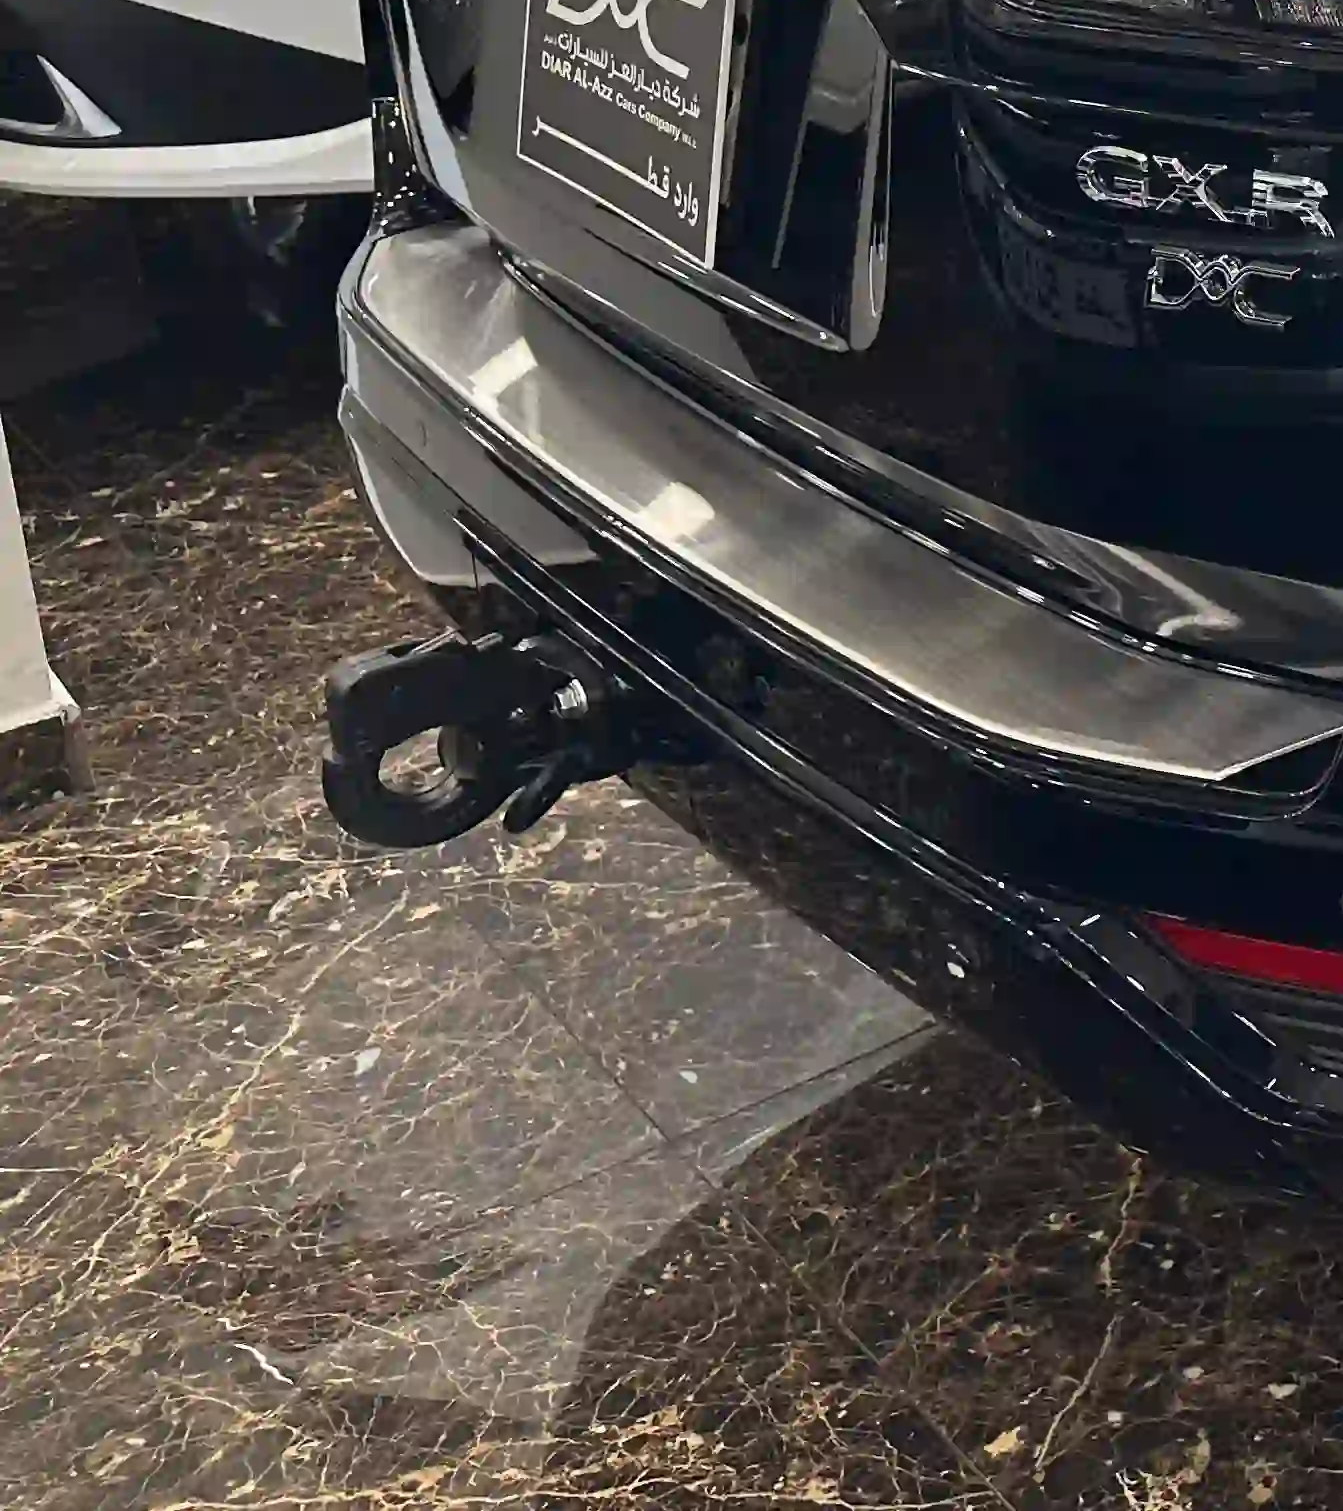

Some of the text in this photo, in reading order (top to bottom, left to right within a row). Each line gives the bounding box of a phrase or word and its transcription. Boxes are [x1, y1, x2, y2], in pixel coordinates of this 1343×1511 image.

[541, 49, 572, 81] DIAR
[615, 92, 637, 115] Cars
[638, 104, 681, 142] Company
[662, 77, 700, 119] شركة
[673, 181, 700, 227] وارد
[1076, 145, 1335, 238] GXR
